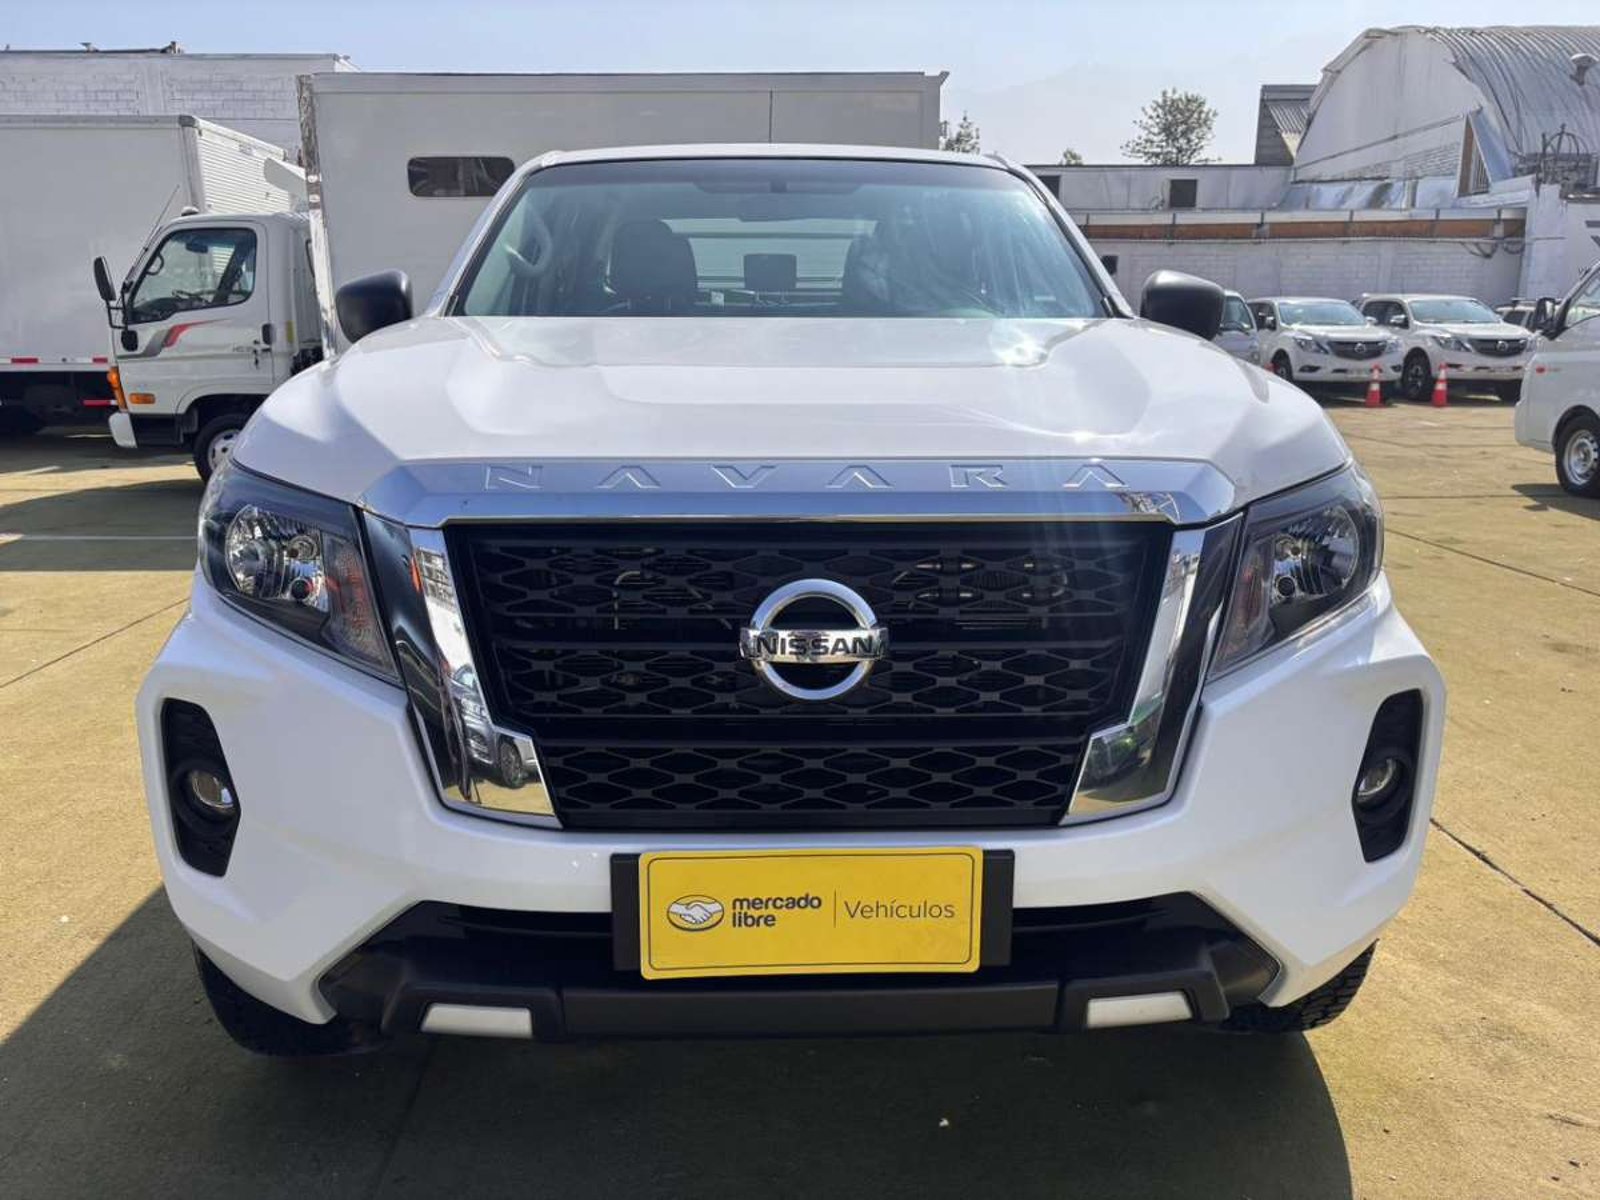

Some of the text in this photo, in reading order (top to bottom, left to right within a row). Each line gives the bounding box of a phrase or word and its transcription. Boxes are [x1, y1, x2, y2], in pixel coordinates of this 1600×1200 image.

[483, 464, 1128, 491] NAVARA
[755, 635, 874, 656] NISSAN
[731, 893, 822, 911] mercado
[844, 900, 955, 920] Vehículos
[731, 911, 776, 929] libre
